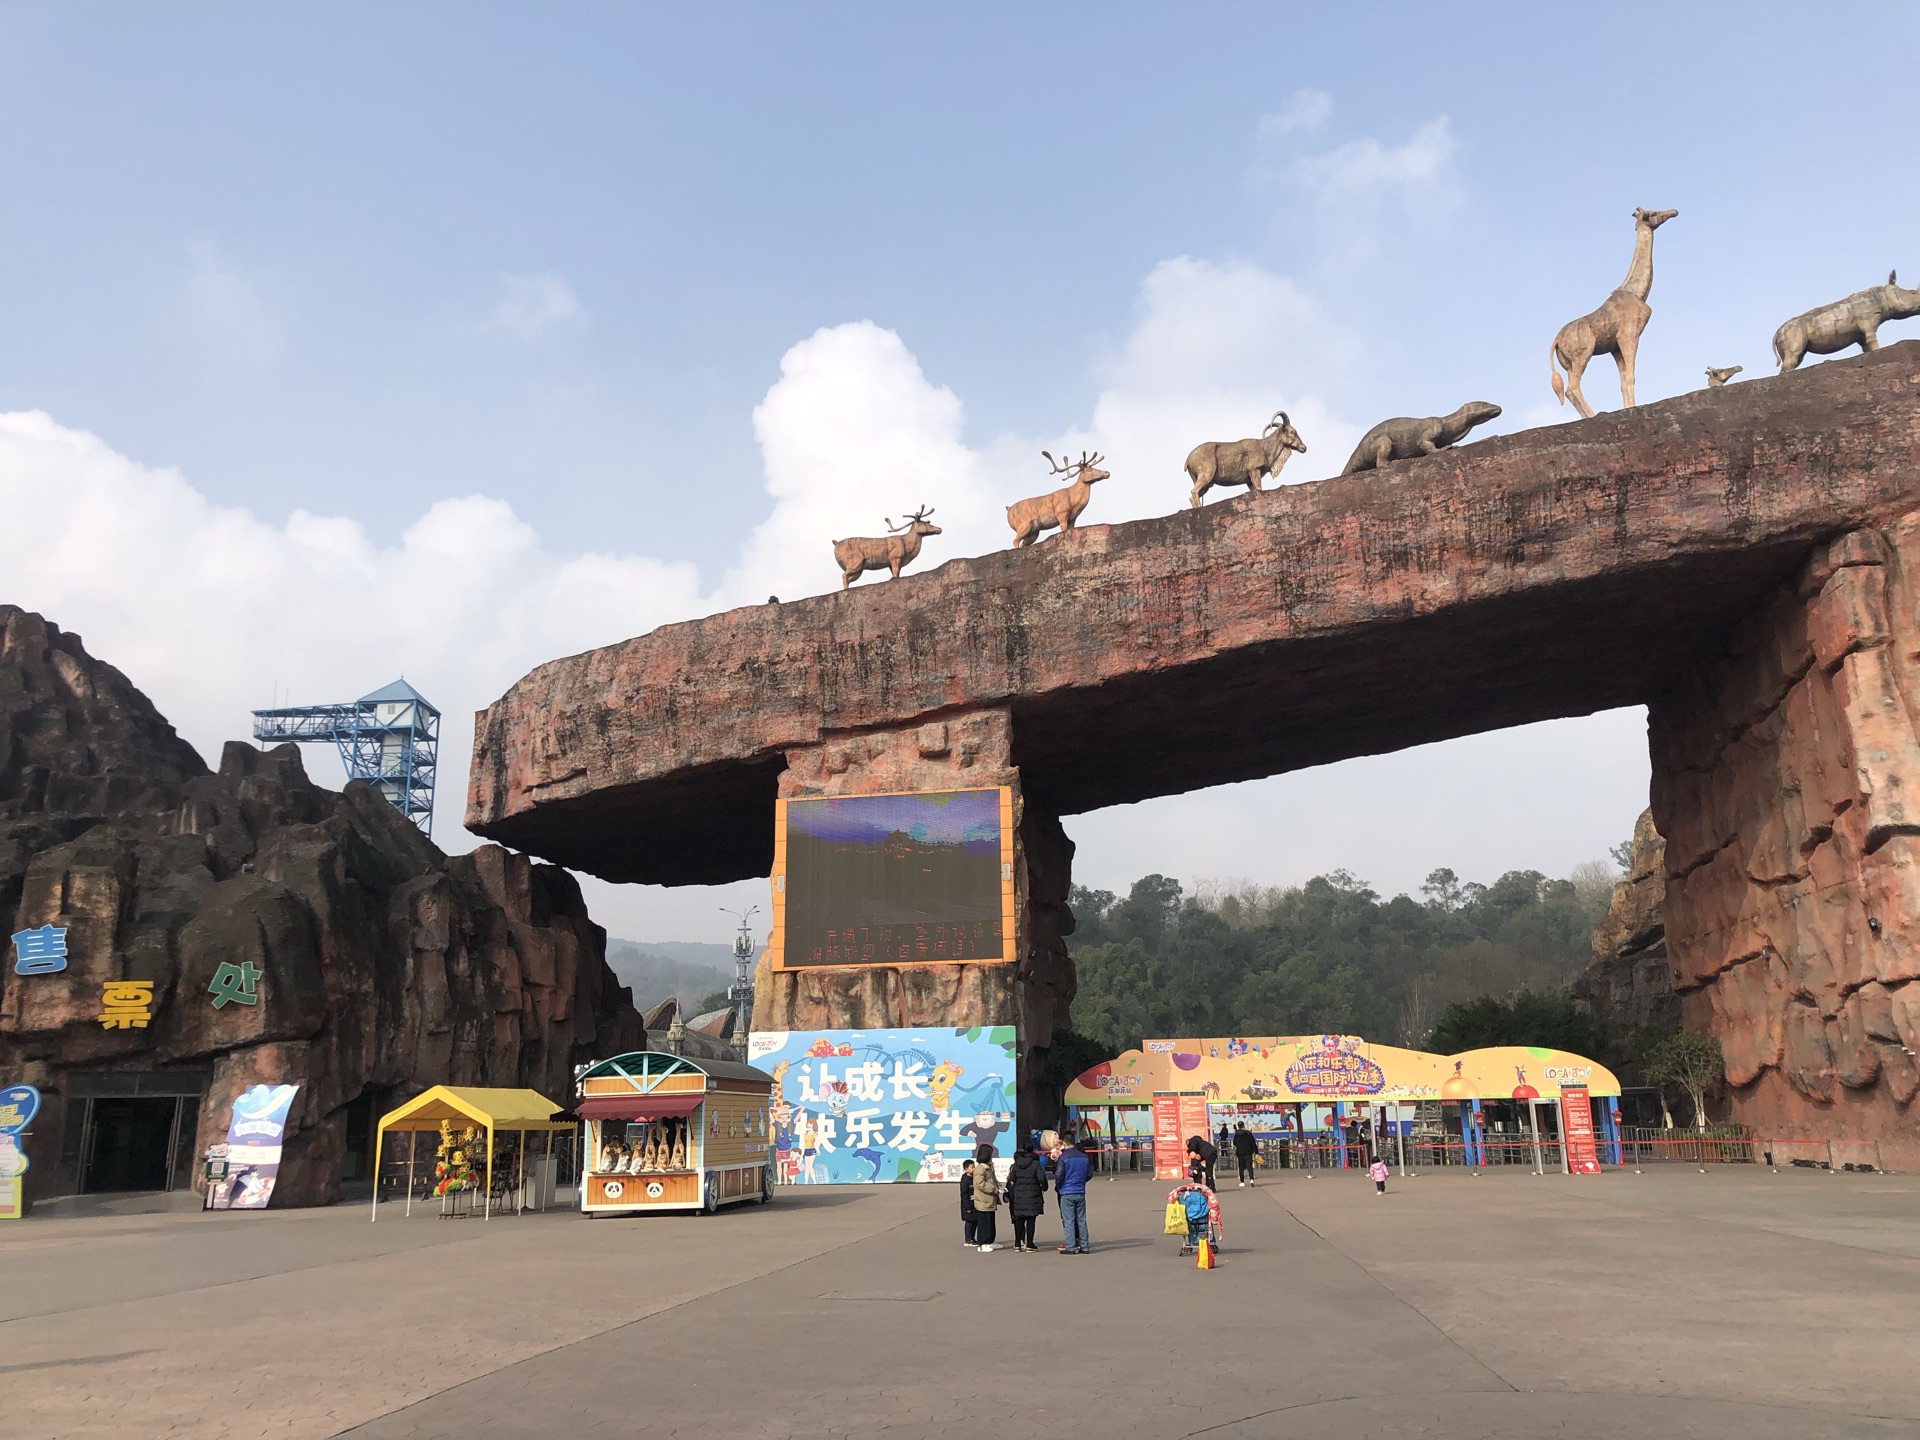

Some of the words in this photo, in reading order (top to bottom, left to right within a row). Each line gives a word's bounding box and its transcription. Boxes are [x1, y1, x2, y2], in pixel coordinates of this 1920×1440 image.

[1288, 1069, 1381, 1088] 第四届国际小丑季
[1304, 1055, 1361, 1071] 乐和乐都
[797, 1060, 929, 1103] 让成长
[794, 1106, 977, 1154] 快乐发生
